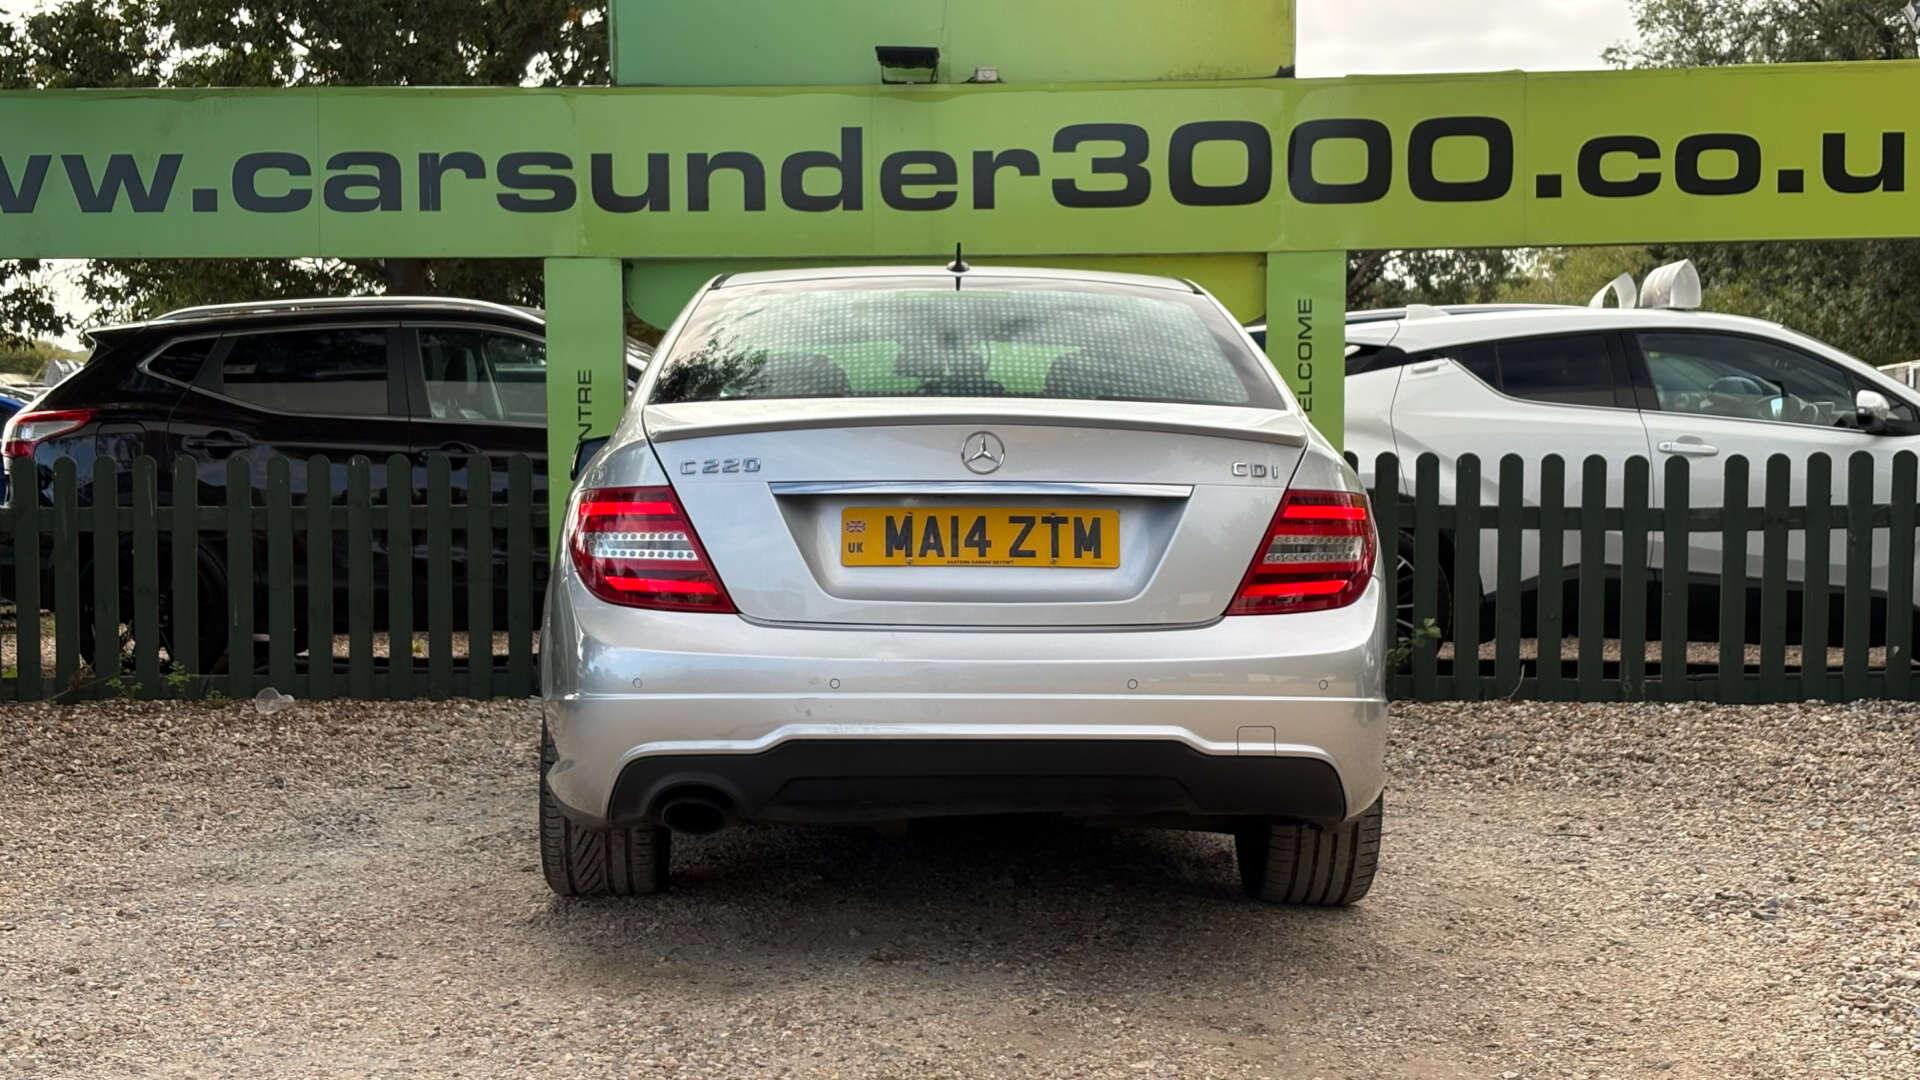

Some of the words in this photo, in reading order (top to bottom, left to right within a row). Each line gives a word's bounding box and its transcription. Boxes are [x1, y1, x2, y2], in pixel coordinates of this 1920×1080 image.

[680, 459, 697, 476] C
[702, 457, 761, 475] 220
[1231, 461, 1279, 479] CDI
[885, 515, 992, 558] MA14
[1008, 515, 1102, 558] ZTM
[847, 542, 864, 554] UK
